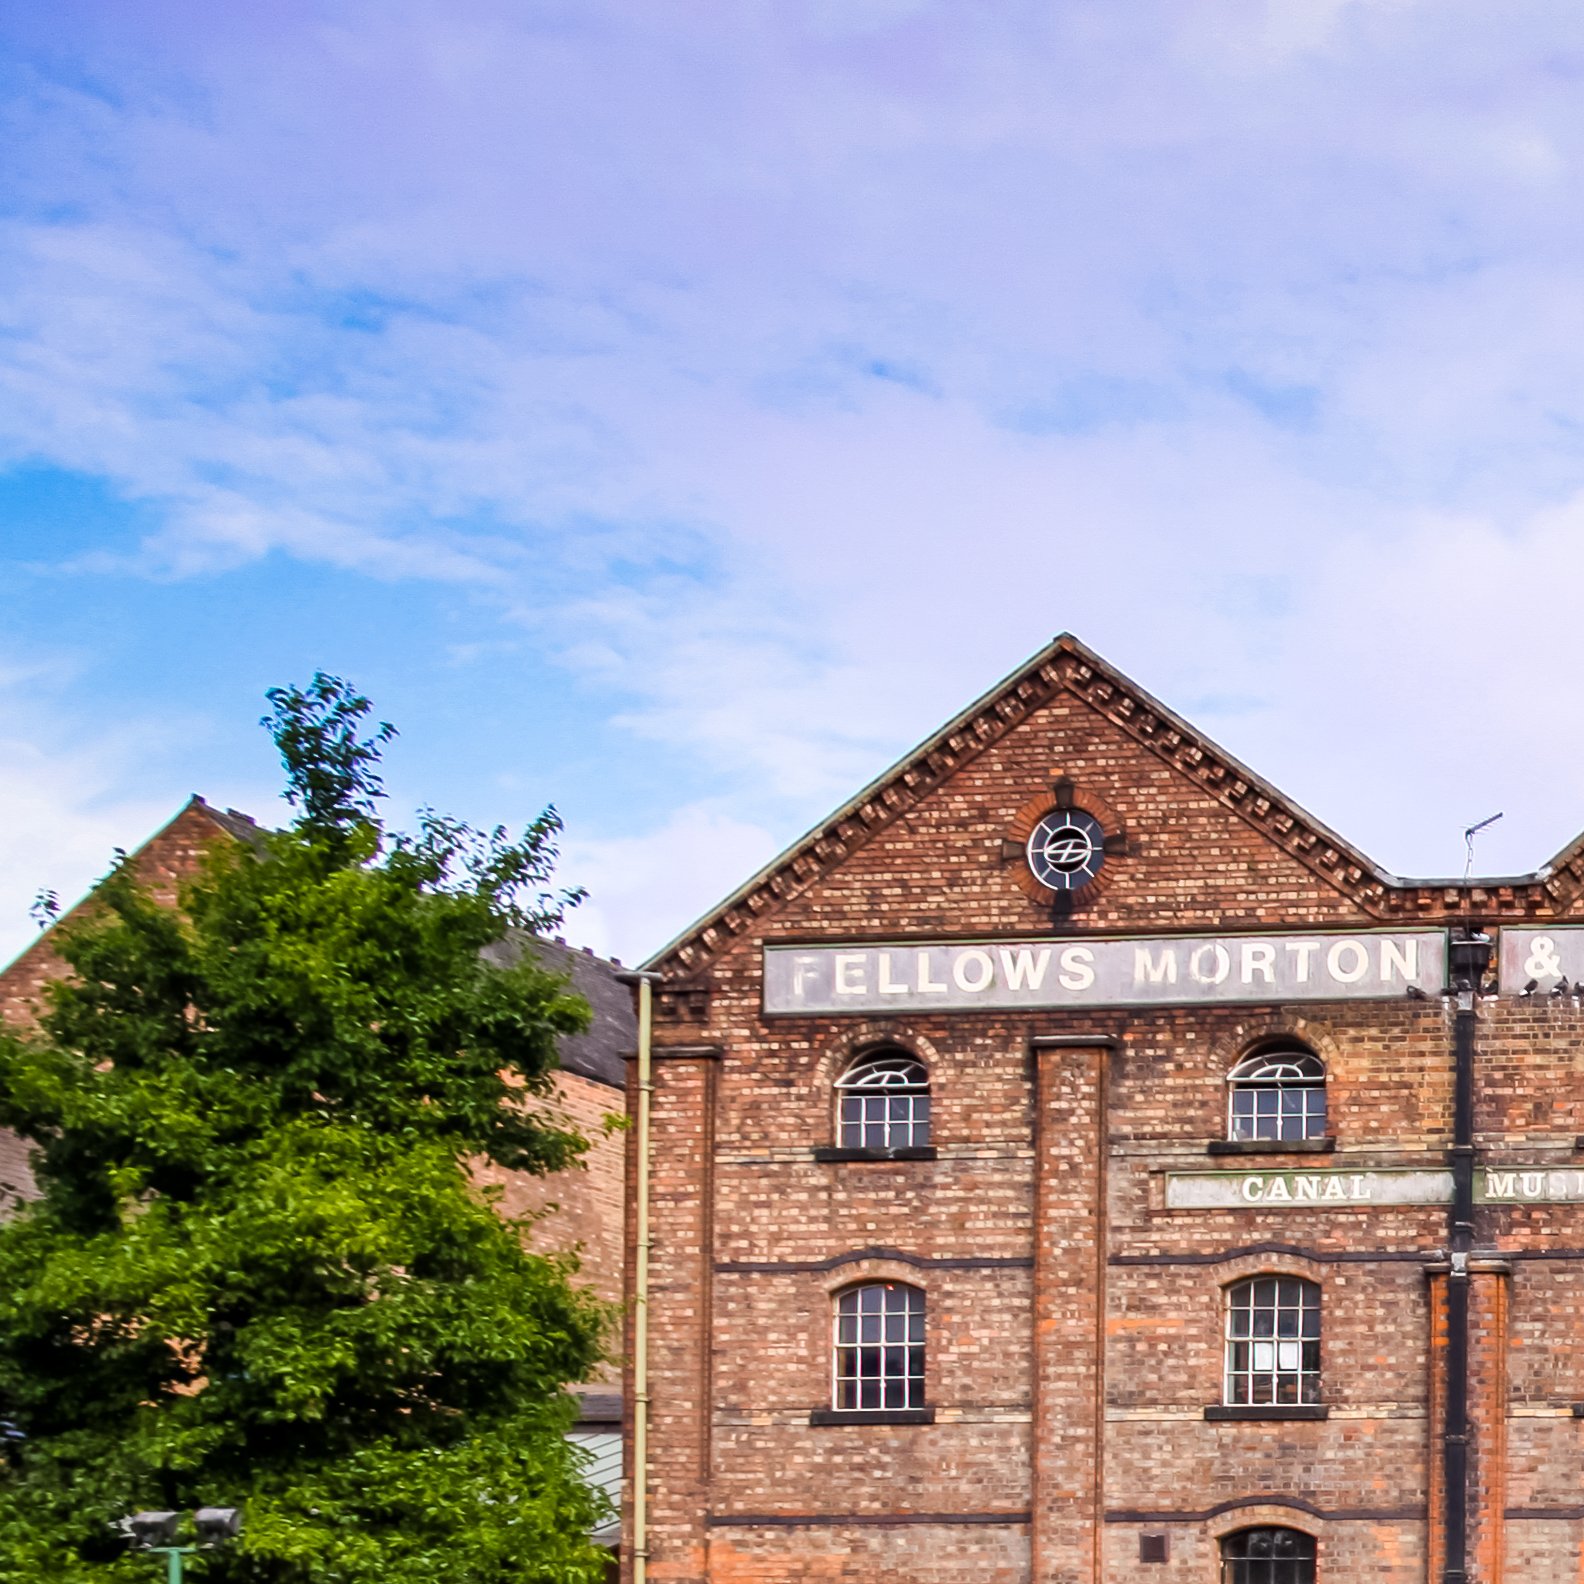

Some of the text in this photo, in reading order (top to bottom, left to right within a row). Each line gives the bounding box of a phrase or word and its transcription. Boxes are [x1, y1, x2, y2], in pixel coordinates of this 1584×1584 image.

[793, 945, 1096, 996] FELLOWS
[1133, 938, 1418, 988] MORTON
[1524, 935, 1563, 979] &
[1240, 1174, 1372, 1202] CANAL
